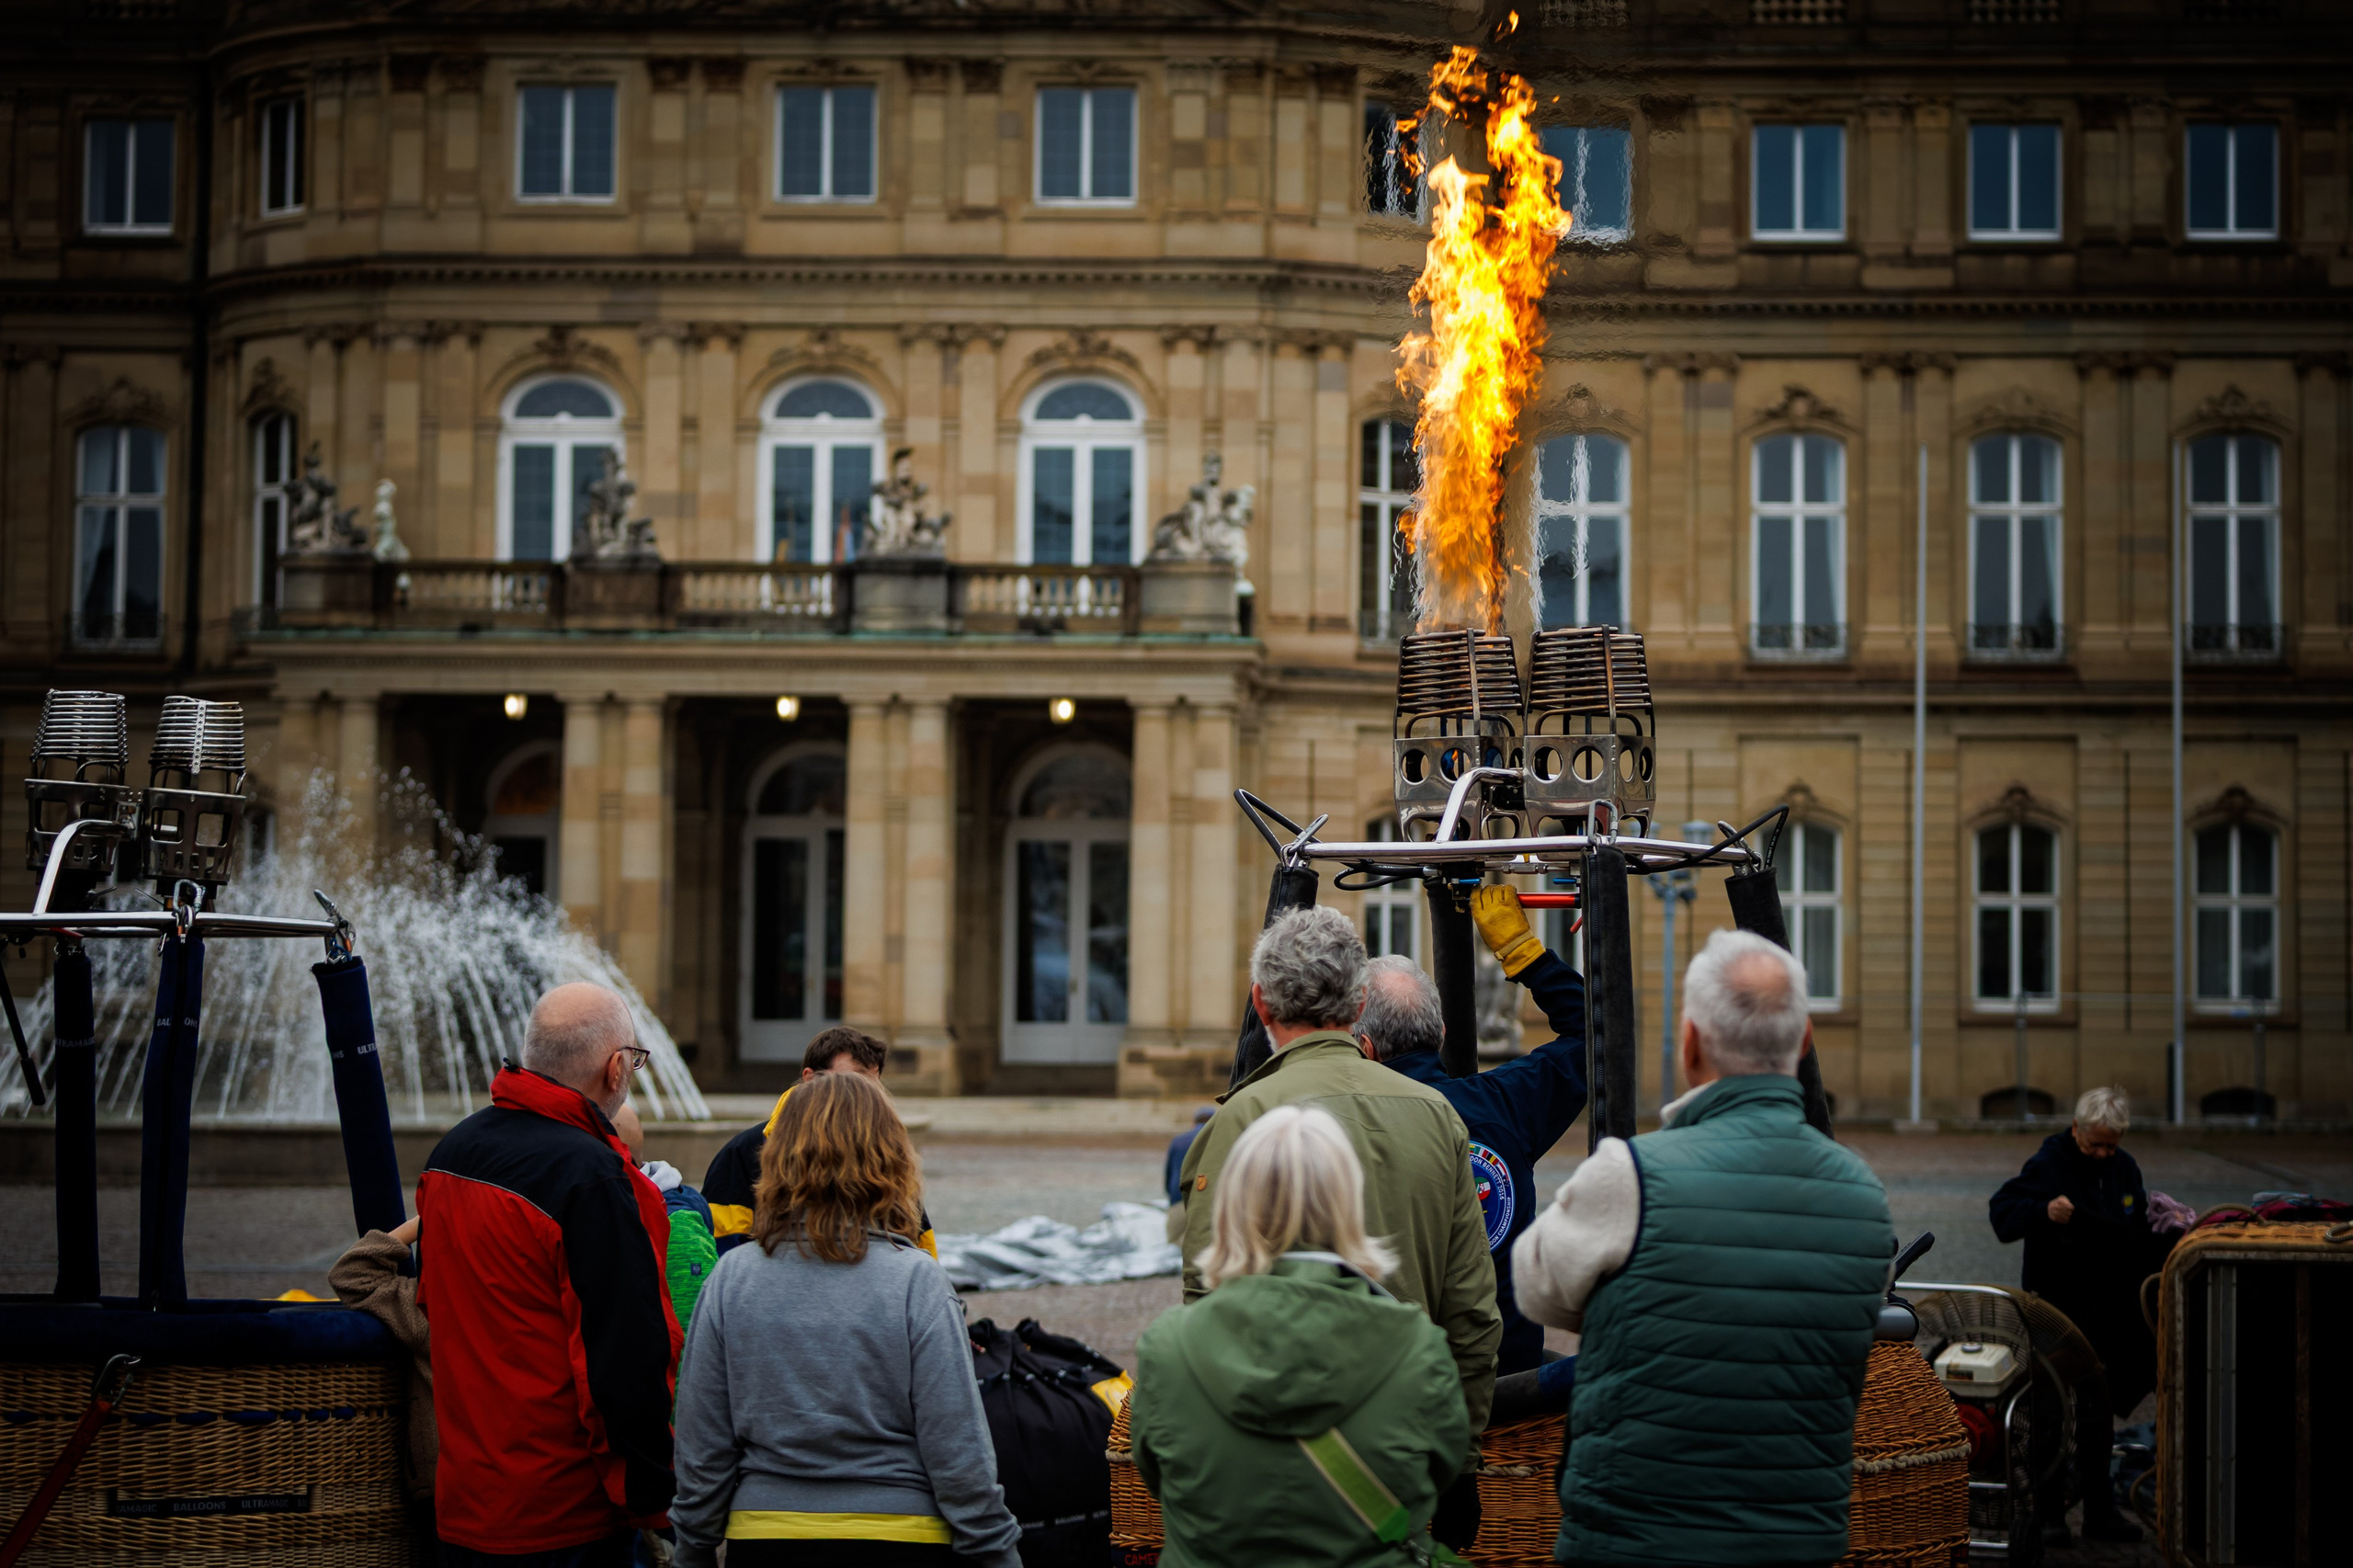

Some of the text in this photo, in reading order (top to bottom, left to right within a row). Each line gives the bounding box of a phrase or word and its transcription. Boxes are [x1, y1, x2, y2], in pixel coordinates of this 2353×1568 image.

[1469, 1155, 1483, 1165] DON
[1482, 1162, 1502, 1184] BENNETT
[1489, 1197, 1512, 1245] OON CHAMPIONSHIP
[172, 1500, 227, 1512] BALLOONS
[241, 1499, 290, 1509] ULTRAMAGIC
